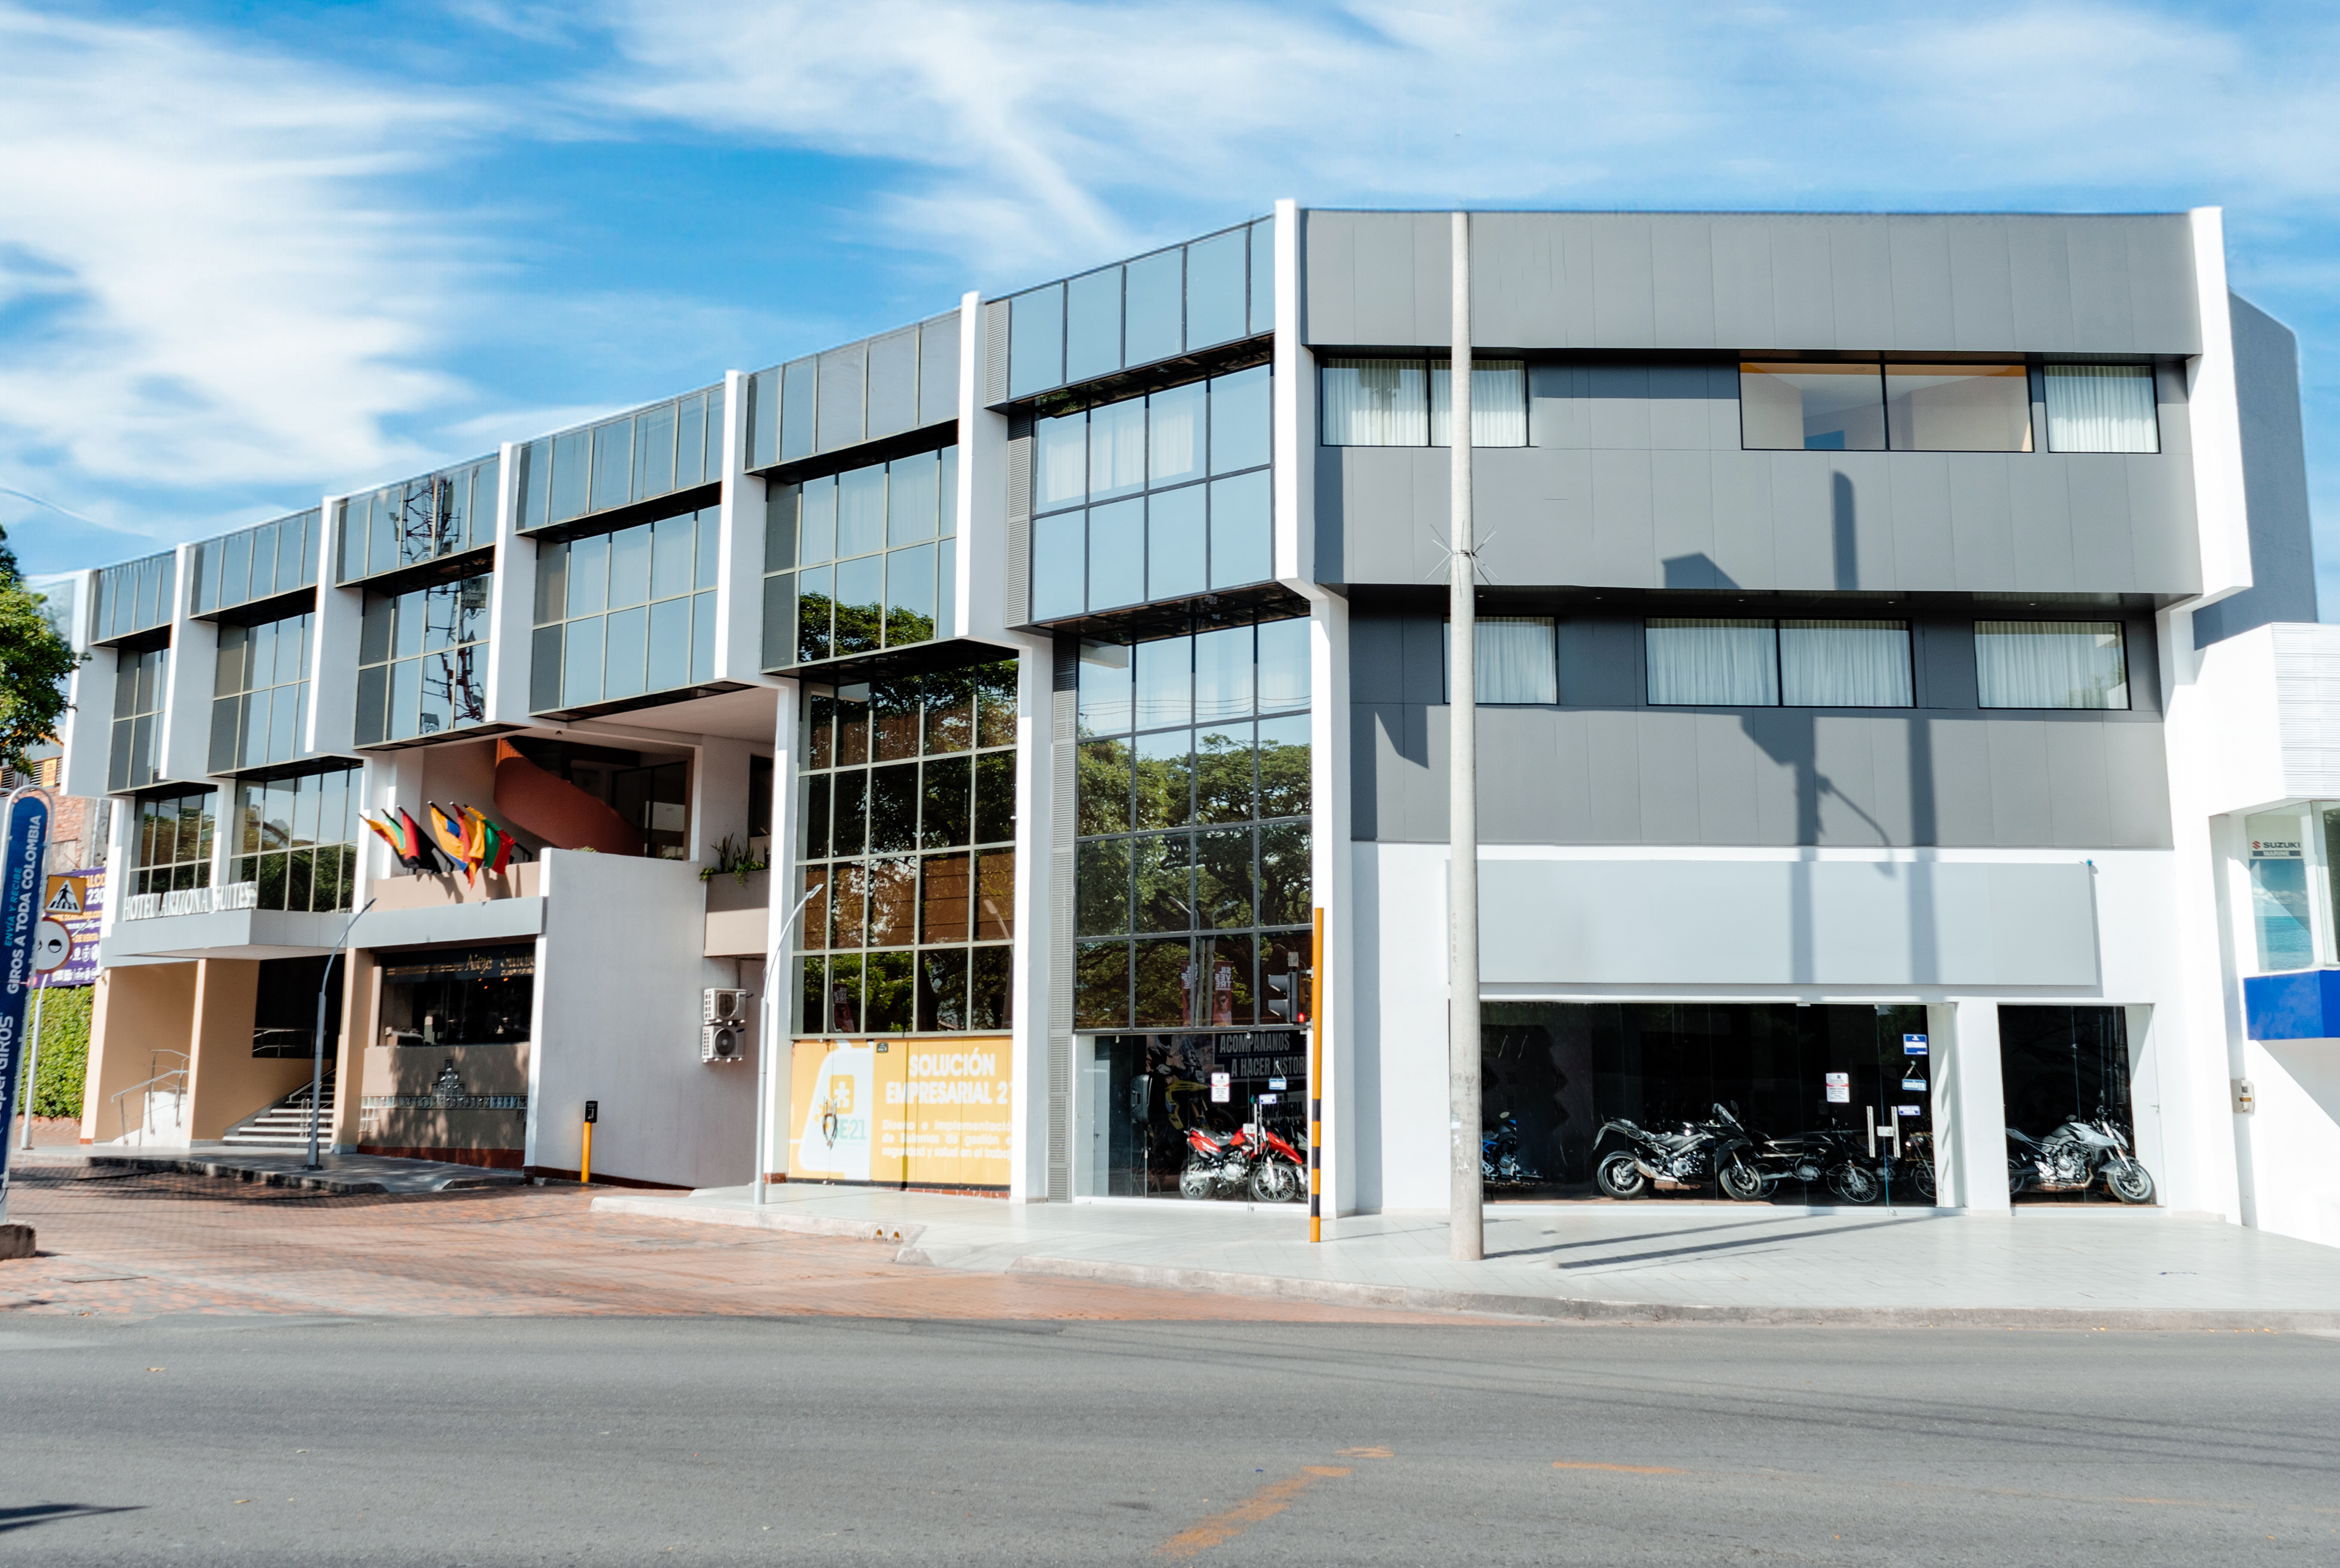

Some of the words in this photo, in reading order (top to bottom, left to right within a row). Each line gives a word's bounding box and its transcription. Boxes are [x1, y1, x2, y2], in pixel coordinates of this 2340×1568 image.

[21, 815, 42, 890] COLOMBIA
[10, 867, 22, 903] RECIBE
[9, 905, 16, 915] Y
[15, 892, 32, 932] TODA
[123, 893, 155, 921] HOTEL
[160, 887, 211, 917] ARIZONA
[213, 881, 251, 911] SUITES
[4, 916, 16, 947] ENVÍA
[13, 935, 26, 947] A
[6, 949, 24, 995] GIROS
[909, 1047, 995, 1077] SOLUCIÓN
[1231, 1058, 1238, 1077] A
[1240, 1057, 1271, 1076] HACER
[886, 1081, 993, 1104] EMPRESARIAL
[996, 1081, 1012, 1104] 2
[921, 1121, 928, 1130] e
[882, 1132, 895, 1143] de
[945, 1133, 959, 1144] de
[964, 1133, 999, 1147] gestión
[927, 1148, 933, 1159] y
[934, 1146, 959, 1157] salud
[960, 1148, 972, 1158] en
[974, 1147, 983, 1158] el
